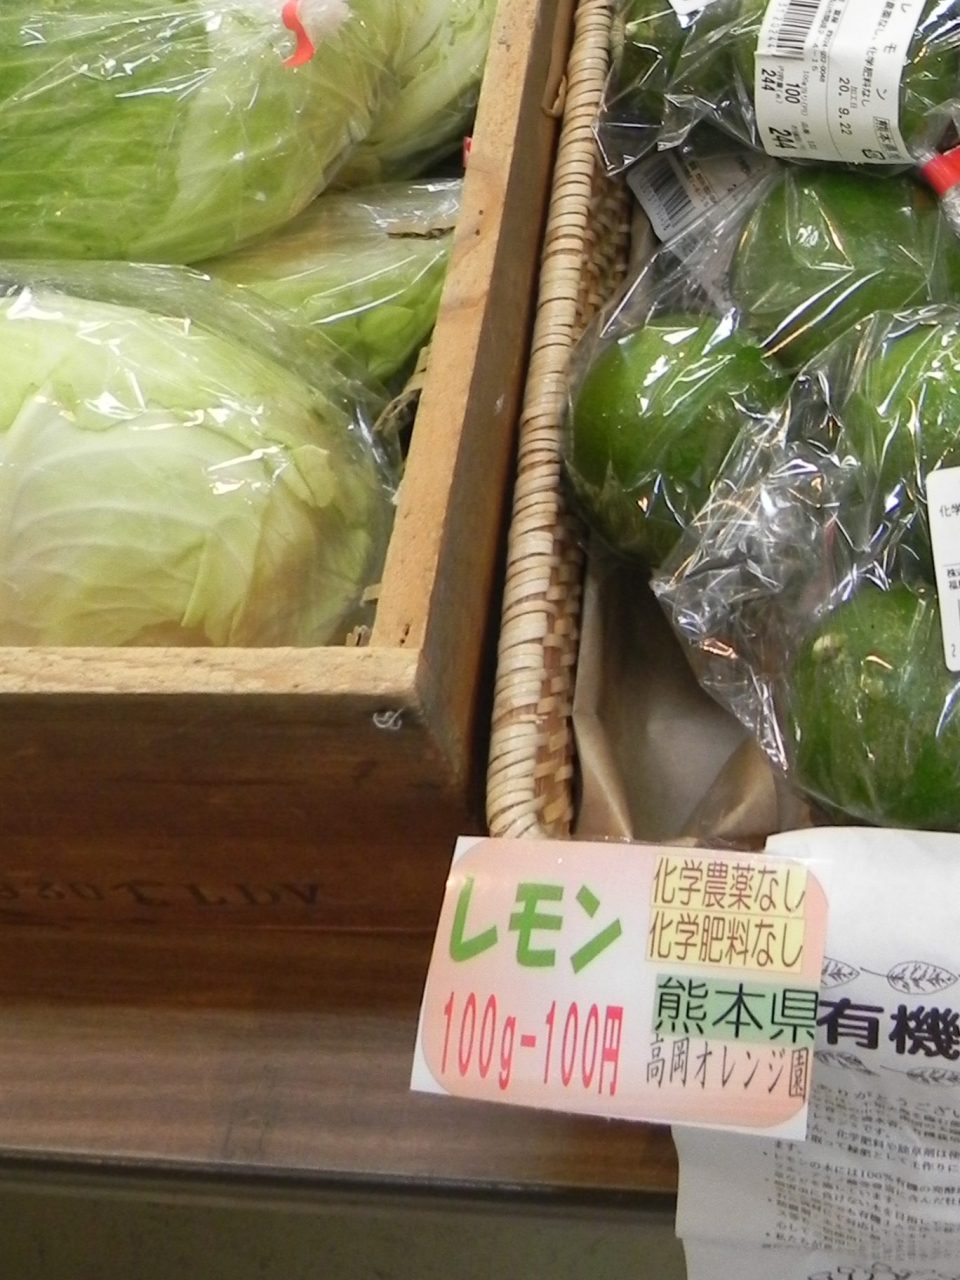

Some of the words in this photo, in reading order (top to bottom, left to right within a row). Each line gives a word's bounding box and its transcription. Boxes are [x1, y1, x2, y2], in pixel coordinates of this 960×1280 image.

[761, 68, 776, 91] 244
[784, 83, 801, 104] 100
[768, 126, 797, 150] 244
[653, 857, 806, 913] 化学農薬なし
[449, 876, 623, 974] レモン
[649, 910, 804, 968] 化学肥料なし
[655, 977, 820, 1044] 熊本県
[441, 991, 624, 1097] 100g-100円
[646, 1033, 810, 1104] 高岡オレンジ園
